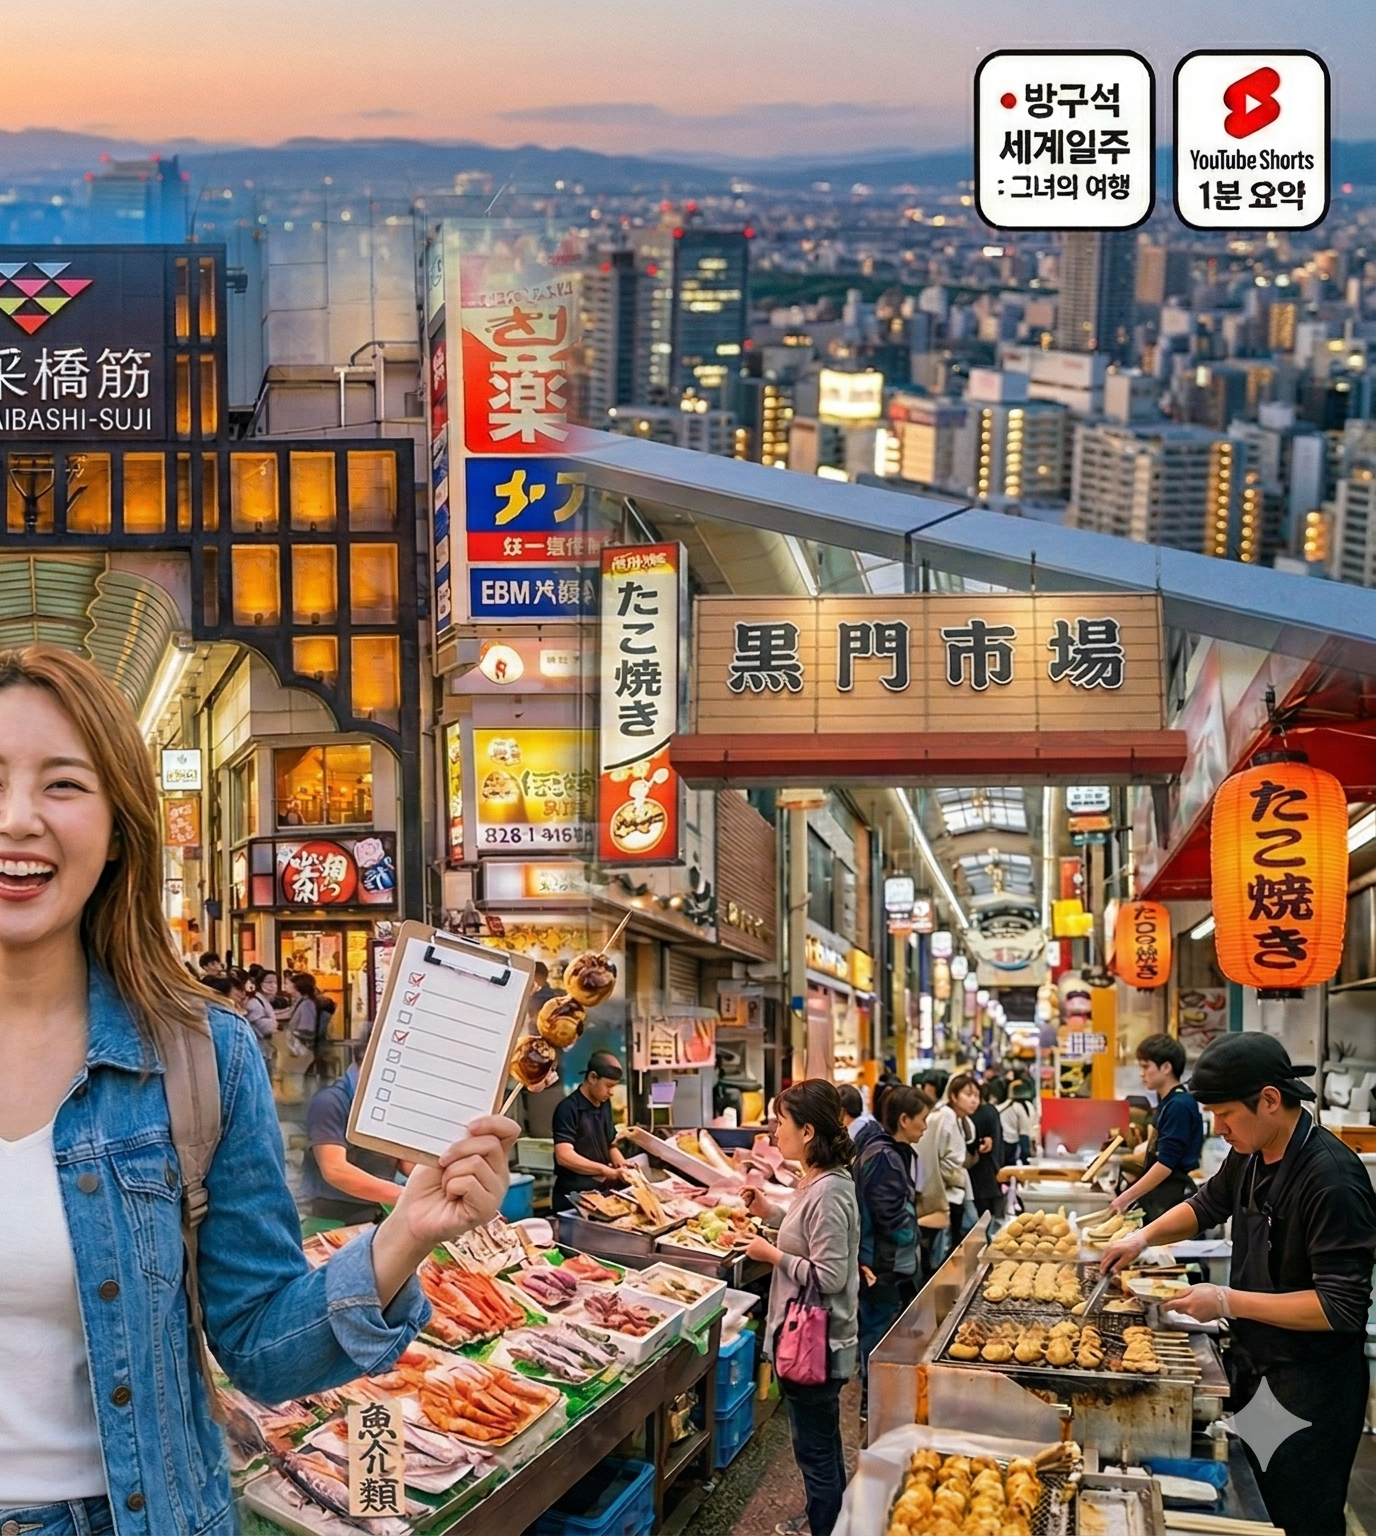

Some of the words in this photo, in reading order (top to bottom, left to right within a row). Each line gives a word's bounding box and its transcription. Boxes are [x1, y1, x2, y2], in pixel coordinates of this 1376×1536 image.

[614, 581, 663, 737] たこ焼き
[726, 617, 1126, 694] 黒門市場
[1246, 779, 1316, 970] たこ焼き
[357, 1402, 399, 1515] 魚介類
